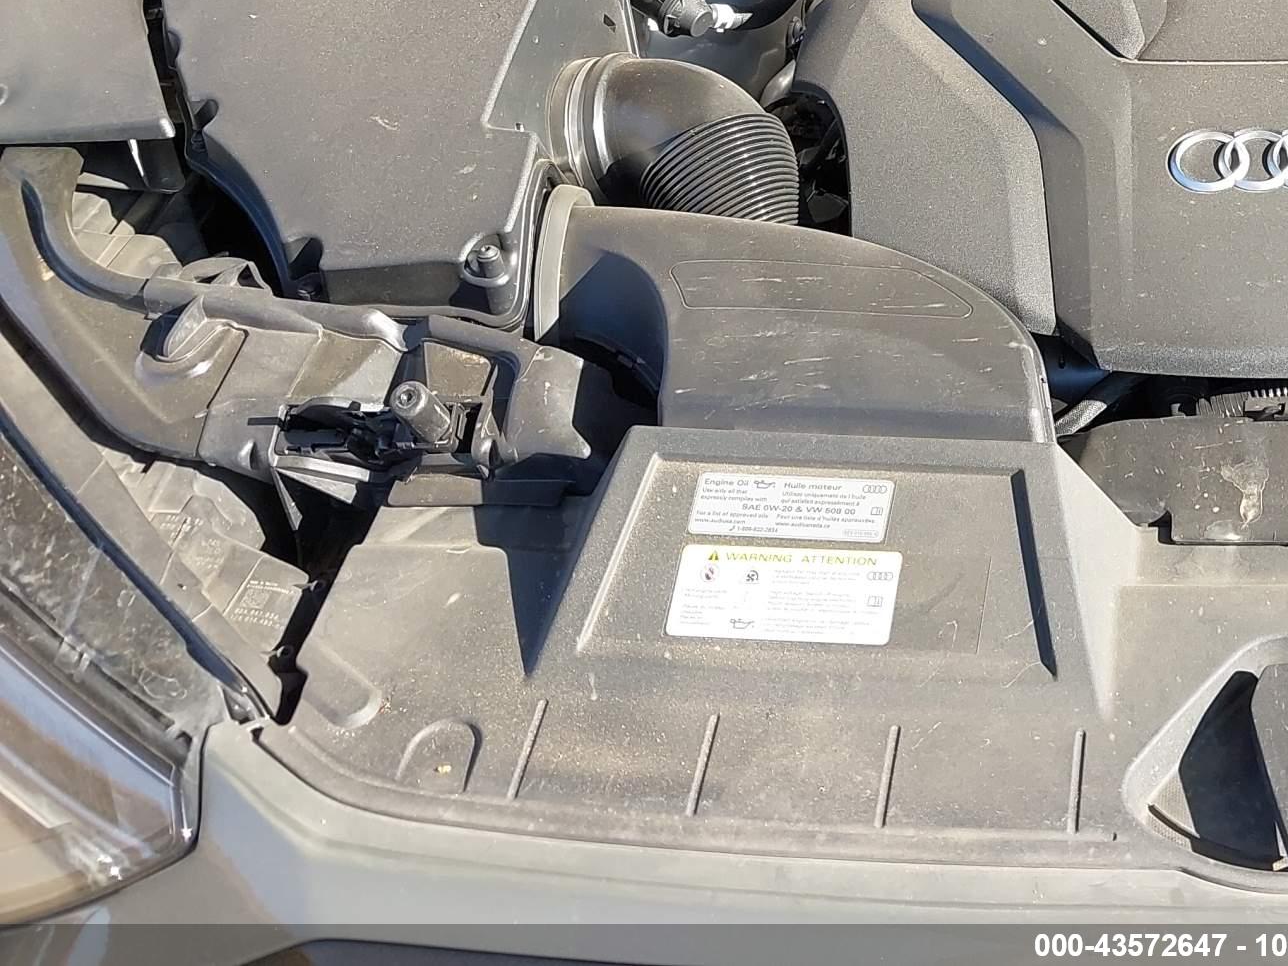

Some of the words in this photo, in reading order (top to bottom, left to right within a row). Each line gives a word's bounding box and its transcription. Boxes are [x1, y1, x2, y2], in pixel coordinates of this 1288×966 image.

[704, 478, 735, 486] Engine
[784, 482, 806, 490] Huile
[763, 505, 793, 513] 0W-20
[726, 553, 792, 563] WARNING
[801, 554, 878, 566] ATTENTION
